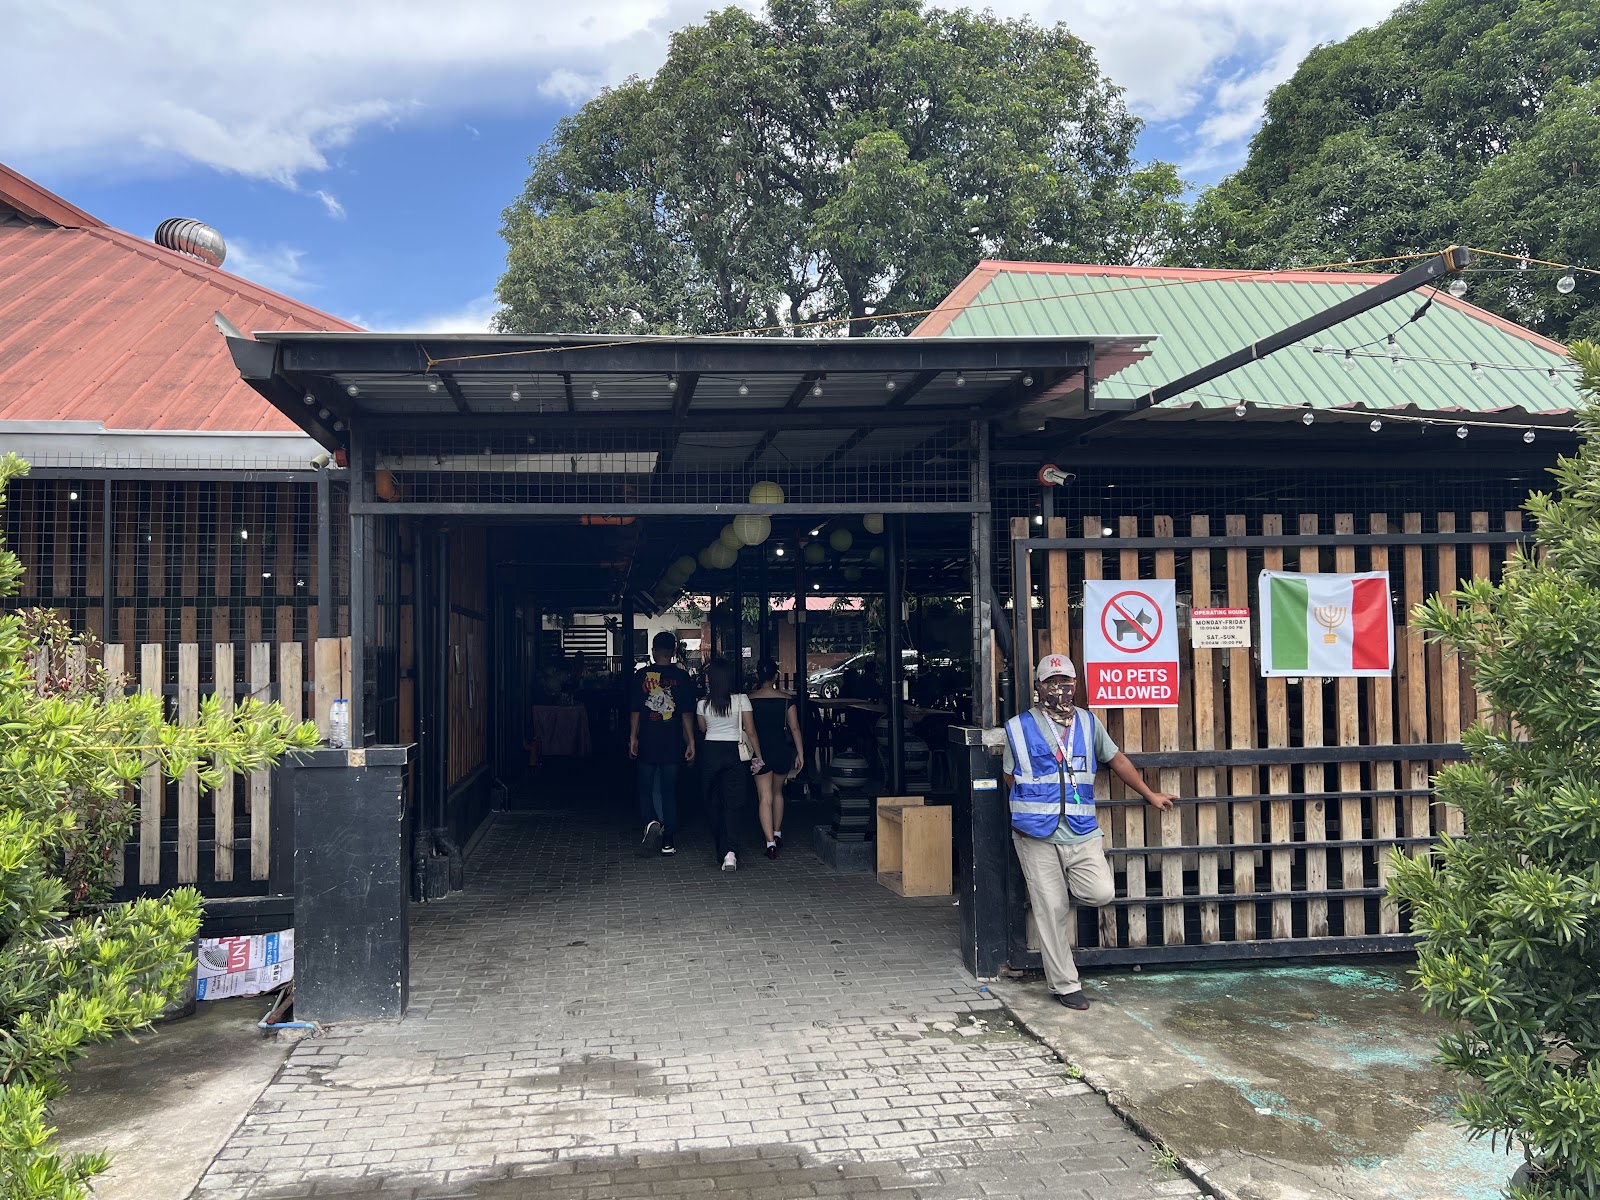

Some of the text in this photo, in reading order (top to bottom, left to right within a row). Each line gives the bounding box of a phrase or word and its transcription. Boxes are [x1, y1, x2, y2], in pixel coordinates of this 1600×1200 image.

[1099, 668, 1168, 683] NO PETS
[1095, 685, 1172, 700] ALLOWED
